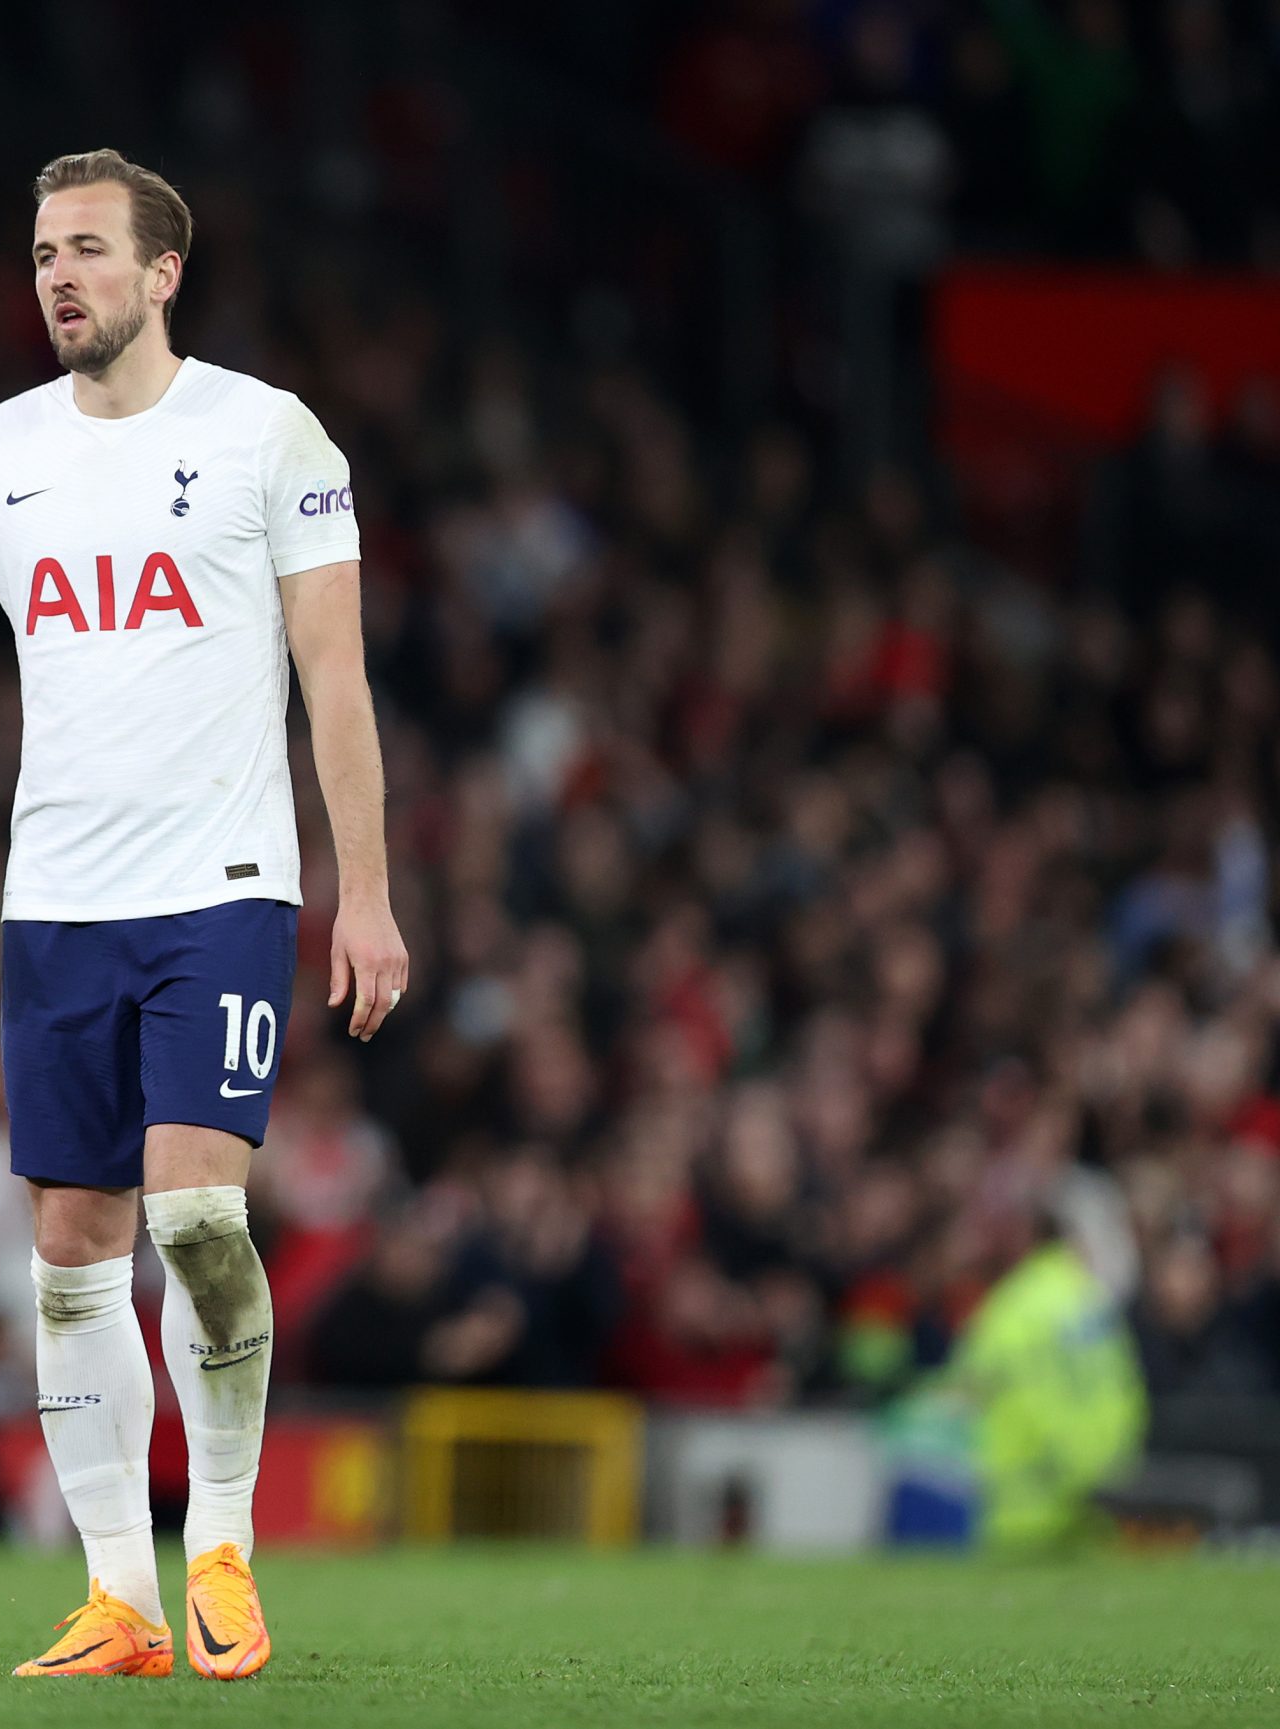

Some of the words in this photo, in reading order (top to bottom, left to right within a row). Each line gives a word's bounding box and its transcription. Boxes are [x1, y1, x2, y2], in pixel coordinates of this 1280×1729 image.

[26, 551, 204, 635] AIA
[219, 993, 276, 1079] 10
[189, 1331, 269, 1356] SPURS
[37, 1393, 102, 1404] PURS
